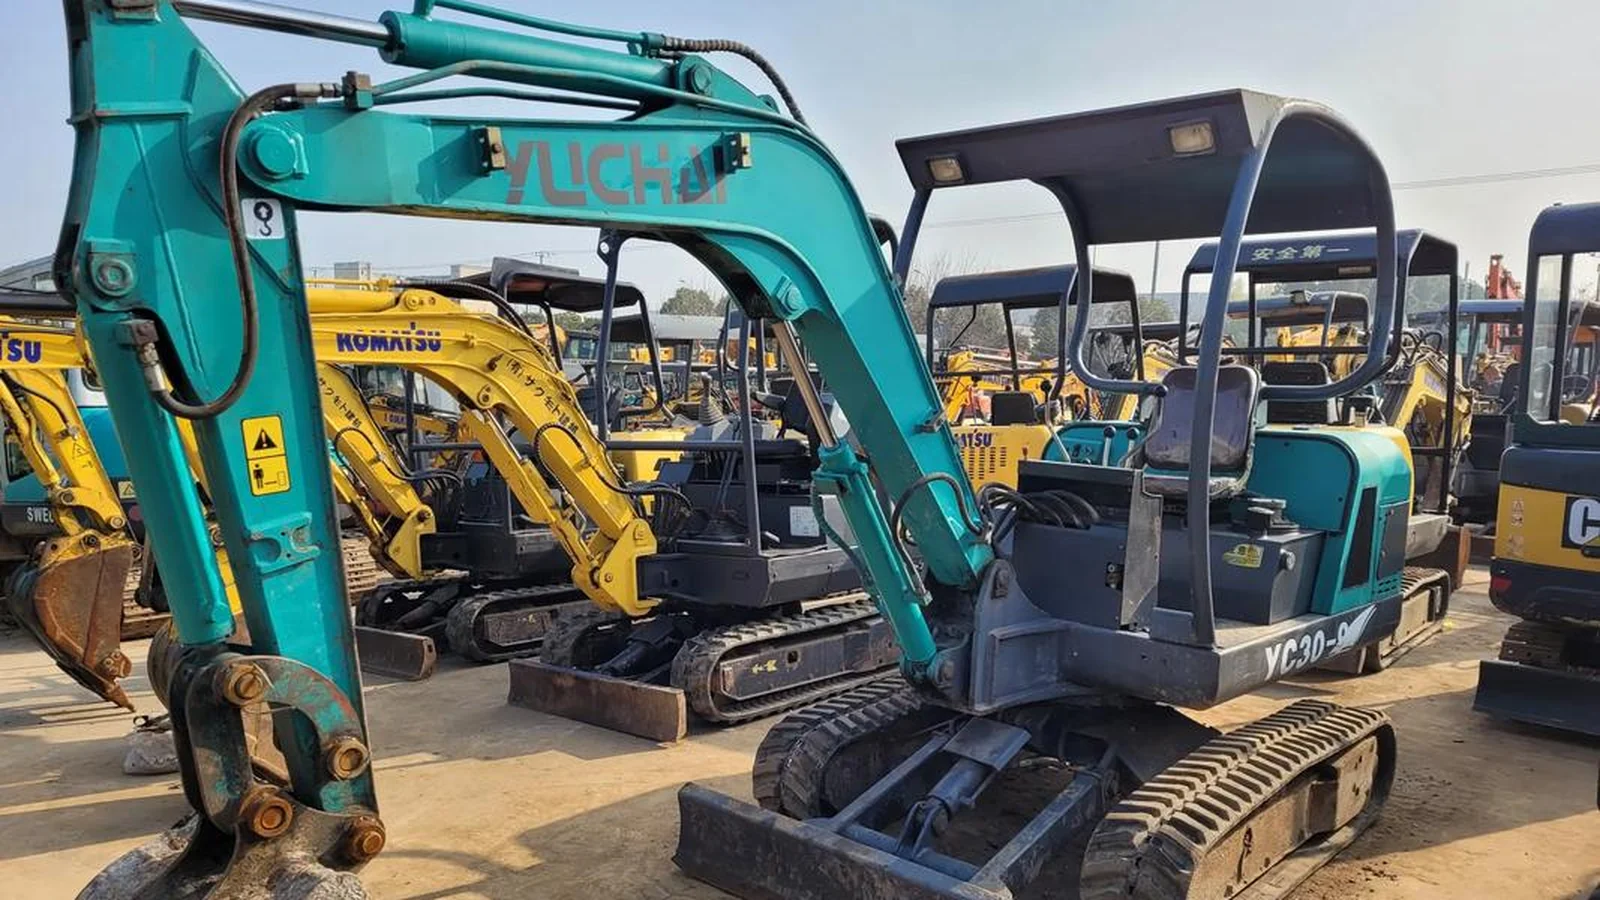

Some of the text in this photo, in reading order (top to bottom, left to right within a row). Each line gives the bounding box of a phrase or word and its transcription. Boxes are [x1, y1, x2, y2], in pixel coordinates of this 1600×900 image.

[504, 140, 729, 204] YUCHAI
[1252, 245, 1350, 261] 安全第一
[0, 331, 42, 364] SU
[336, 322, 441, 352] KOMATSU
